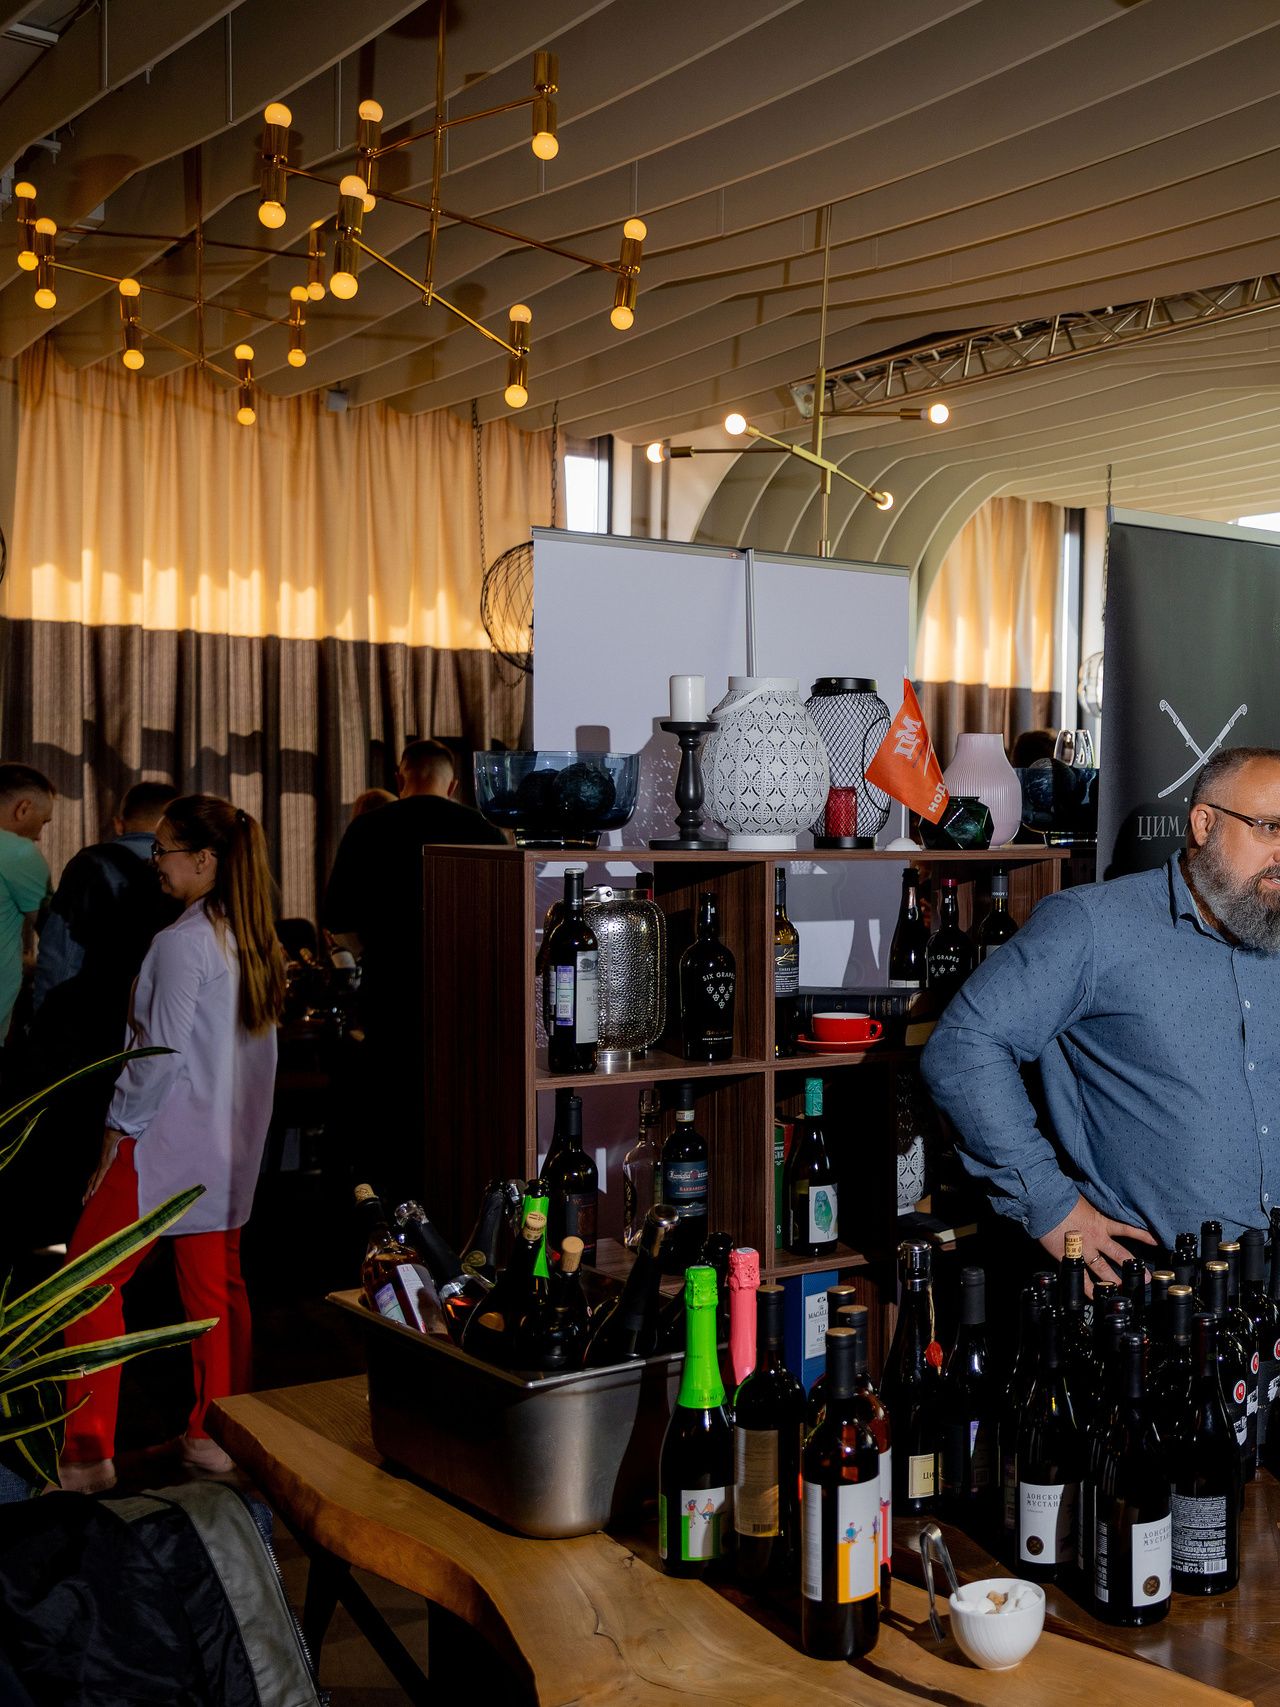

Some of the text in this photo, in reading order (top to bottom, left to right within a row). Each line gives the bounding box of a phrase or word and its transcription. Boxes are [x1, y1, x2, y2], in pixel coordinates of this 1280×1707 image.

[937, 954, 960, 963] GRAPES
[702, 973, 714, 982] SIX
[808, 1309, 828, 1320] MACALL
[818, 1324, 826, 1333] 12
